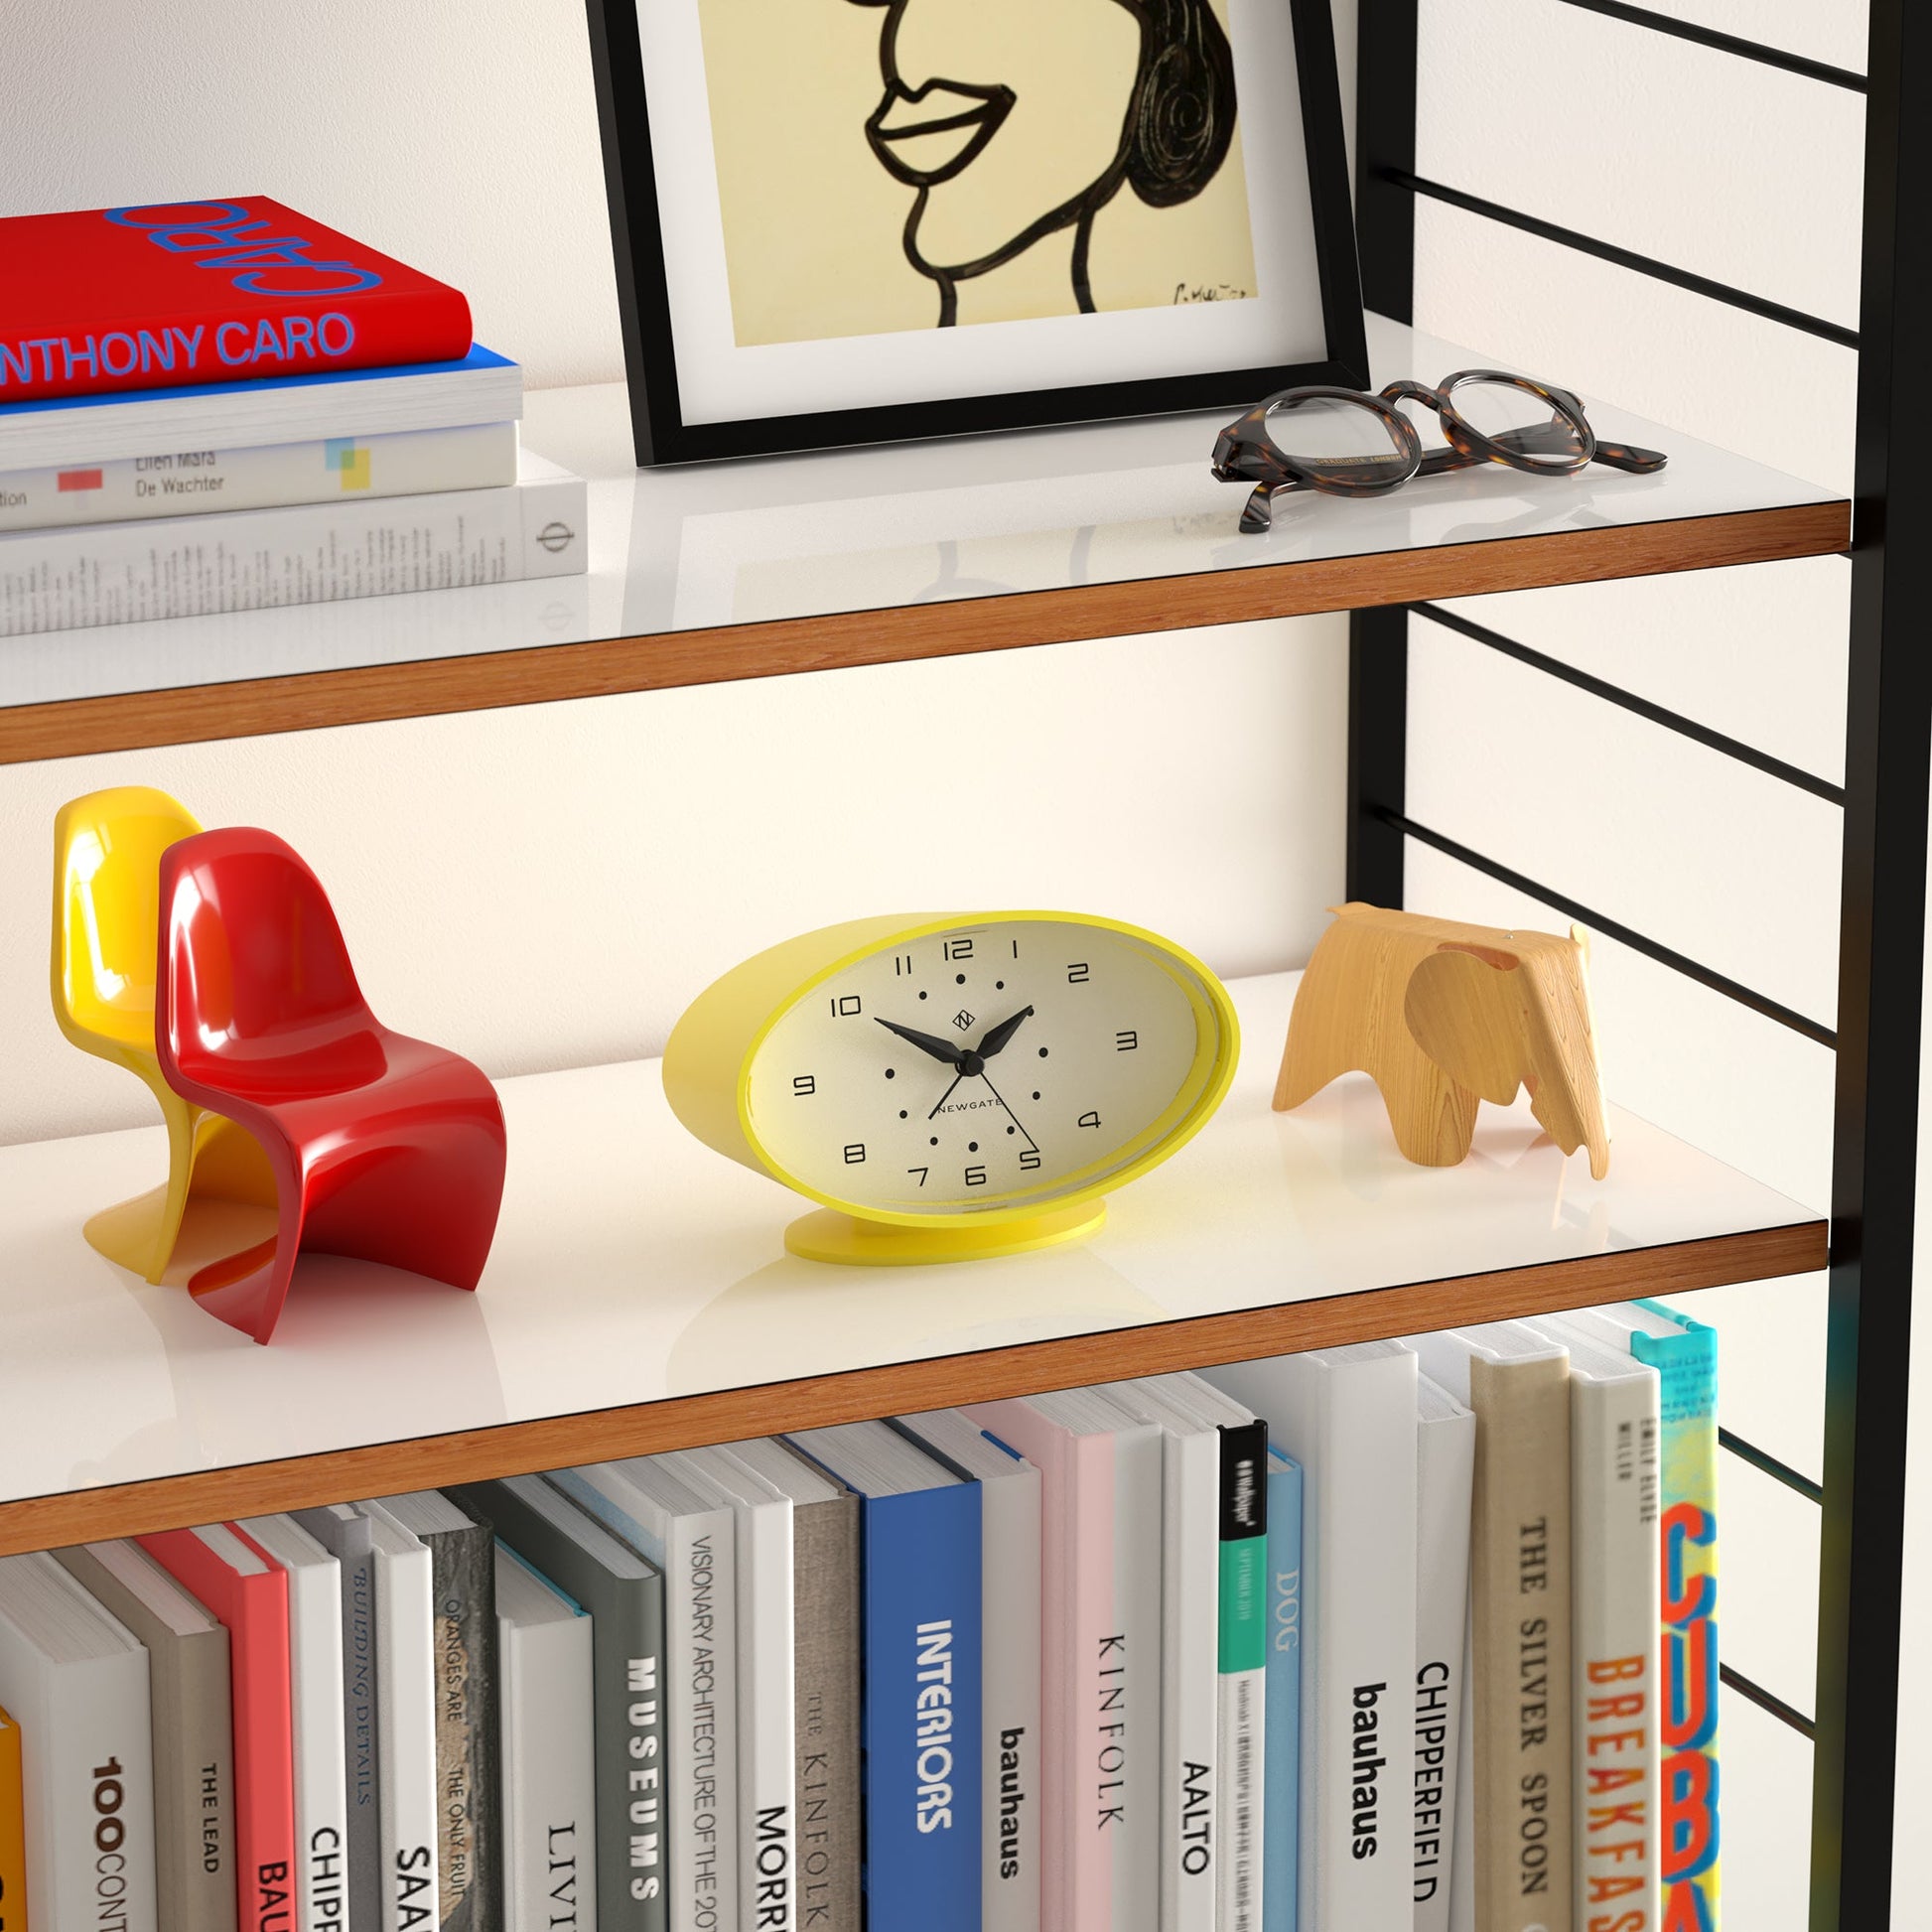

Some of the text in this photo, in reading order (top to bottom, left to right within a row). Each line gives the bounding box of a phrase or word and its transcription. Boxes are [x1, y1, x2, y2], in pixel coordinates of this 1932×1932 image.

[103, 201, 383, 296] CARO
[215, 313, 355, 365] CARO
[136, 476, 224, 497] De Wachter
[896, 955, 911, 976] 11
[943, 939, 973, 961] 12
[1067, 963, 1089, 983] 2
[830, 996, 861, 1018] 10
[1116, 1031, 1138, 1050] 3
[793, 1075, 815, 1096] 9
[937, 1098, 1004, 1114] NEWGATE
[1078, 1111, 1101, 1129] 4
[844, 1144, 866, 1164] 8
[907, 1168, 929, 1186] 7
[965, 1166, 986, 1185] 6
[1019, 1151, 1041, 1171] 5
[691, 1535, 714, 1642] VISIONARY
[1275, 1570, 1300, 1653] DOG
[352, 1568, 370, 1805] BUILDING DETAILS
[916, 1619, 953, 1834] INTERIORS
[1520, 1517, 1549, 1896] THE SILVER SPOON
[445, 1599, 466, 1896] ORANGES ARE THE ONLY FRUIT
[693, 1647, 715, 1811] ARCHITECTURE
[1098, 1633, 1126, 1831] KINFOLK
[1352, 1682, 1386, 1860] bauhaus
[202, 1763, 219, 1873] THE LEAD
[627, 1656, 659, 1900] MUSEUMS
[804, 1691, 830, 1926] THE KINFOLK
[1000, 1726, 1025, 1880] bauhaus
[1182, 1760, 1210, 1875] AALTO
[694, 1813, 716, 1843] OF
[695, 1846, 716, 1892] THE
[756, 1806, 787, 1932] MORR
[397, 1846, 432, 1932] SAA
[548, 1821, 576, 1932] LIVI
